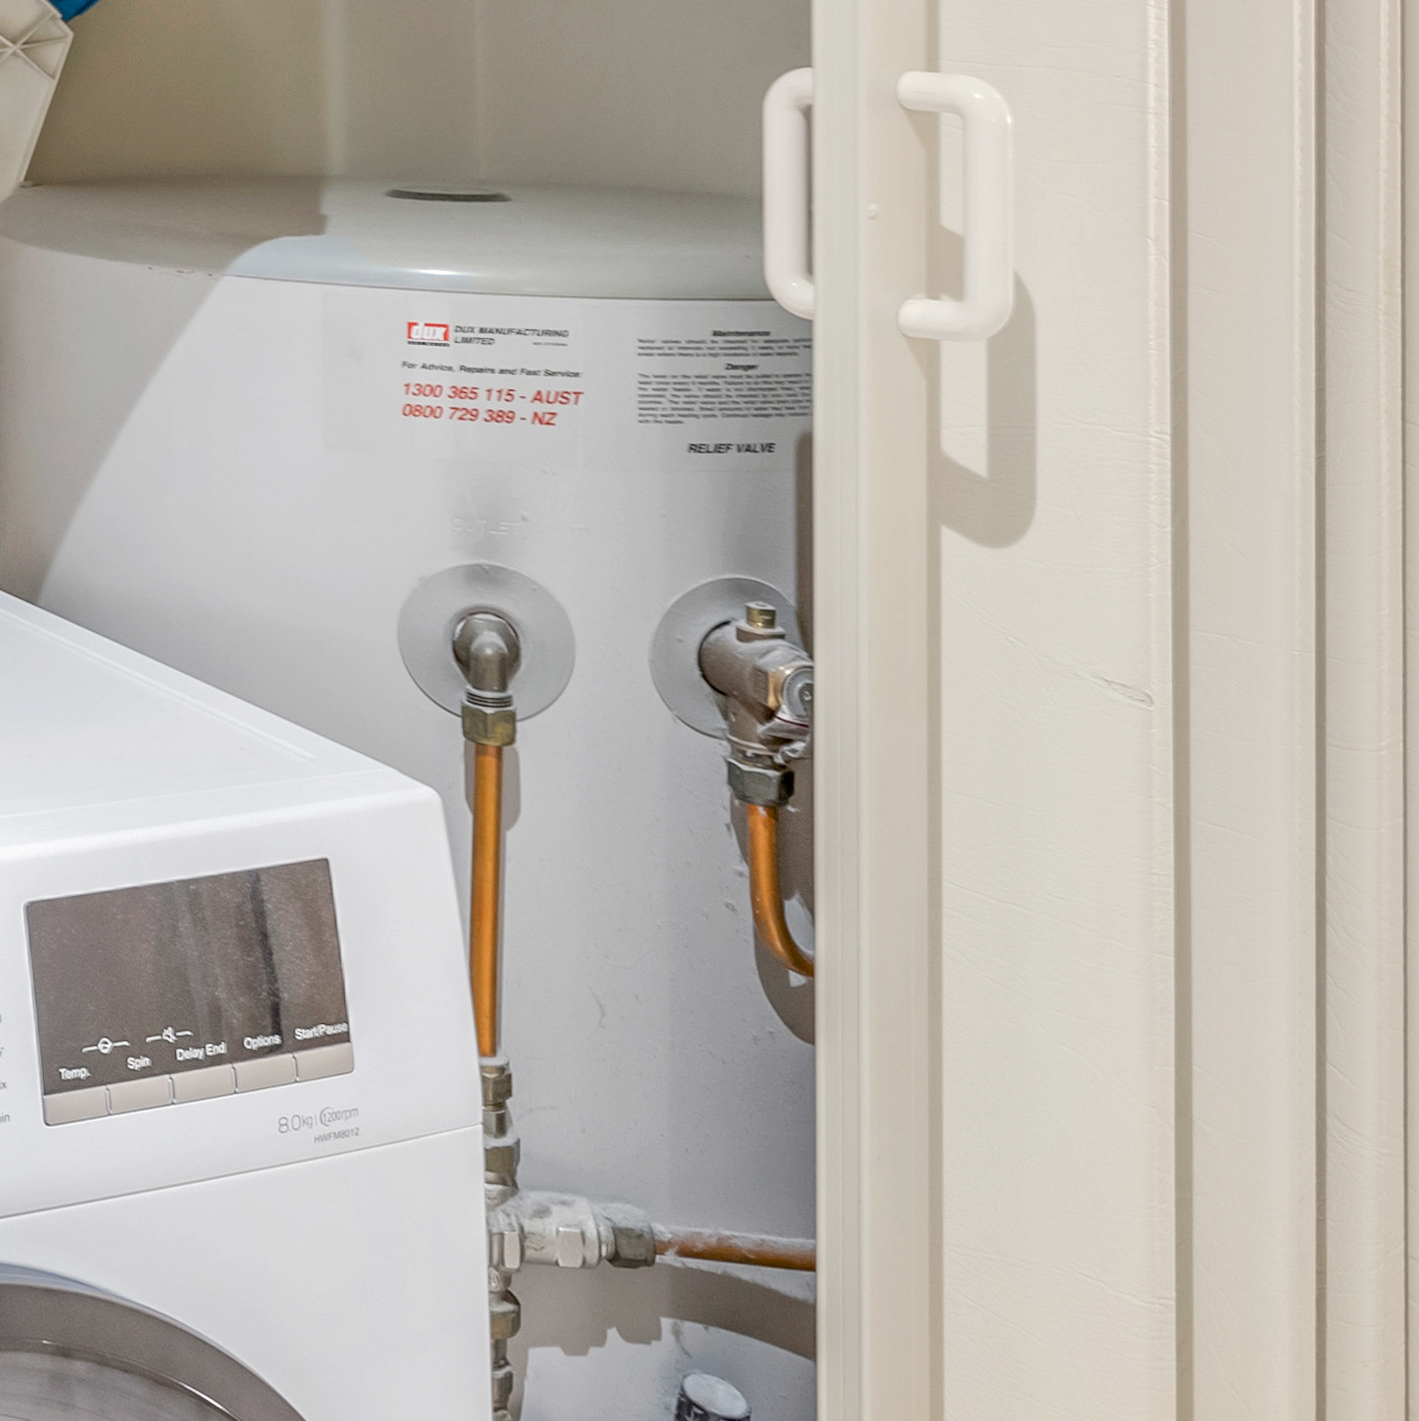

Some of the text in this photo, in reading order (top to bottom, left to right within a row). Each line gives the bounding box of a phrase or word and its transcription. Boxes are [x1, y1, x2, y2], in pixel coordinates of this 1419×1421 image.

[410, 322, 448, 340] dux
[454, 337, 495, 345] LIMITED
[401, 361, 417, 369] For
[421, 363, 455, 372] Advice,
[459, 365, 496, 375] Repairs
[519, 367, 541, 376] Fast
[543, 369, 583, 378] Service:
[403, 382, 443, 397] 1300
[447, 385, 479, 400] 365
[485, 388, 516, 402] 115
[531, 390, 584, 405] AUST
[402, 404, 443, 419] 0800
[448, 406, 479, 421] 729
[483, 409, 516, 424] 389
[531, 411, 558, 426] NZ
[688, 443, 776, 453] RELIEF VALVE
[294, 1021, 349, 1041] Start/Pause
[243, 1034, 282, 1050] Options
[176, 1042, 227, 1061] Delay End
[127, 1056, 152, 1071] Spin
[58, 1066, 90, 1080] Temp.
[314, 1127, 360, 1144] HWFM8012
